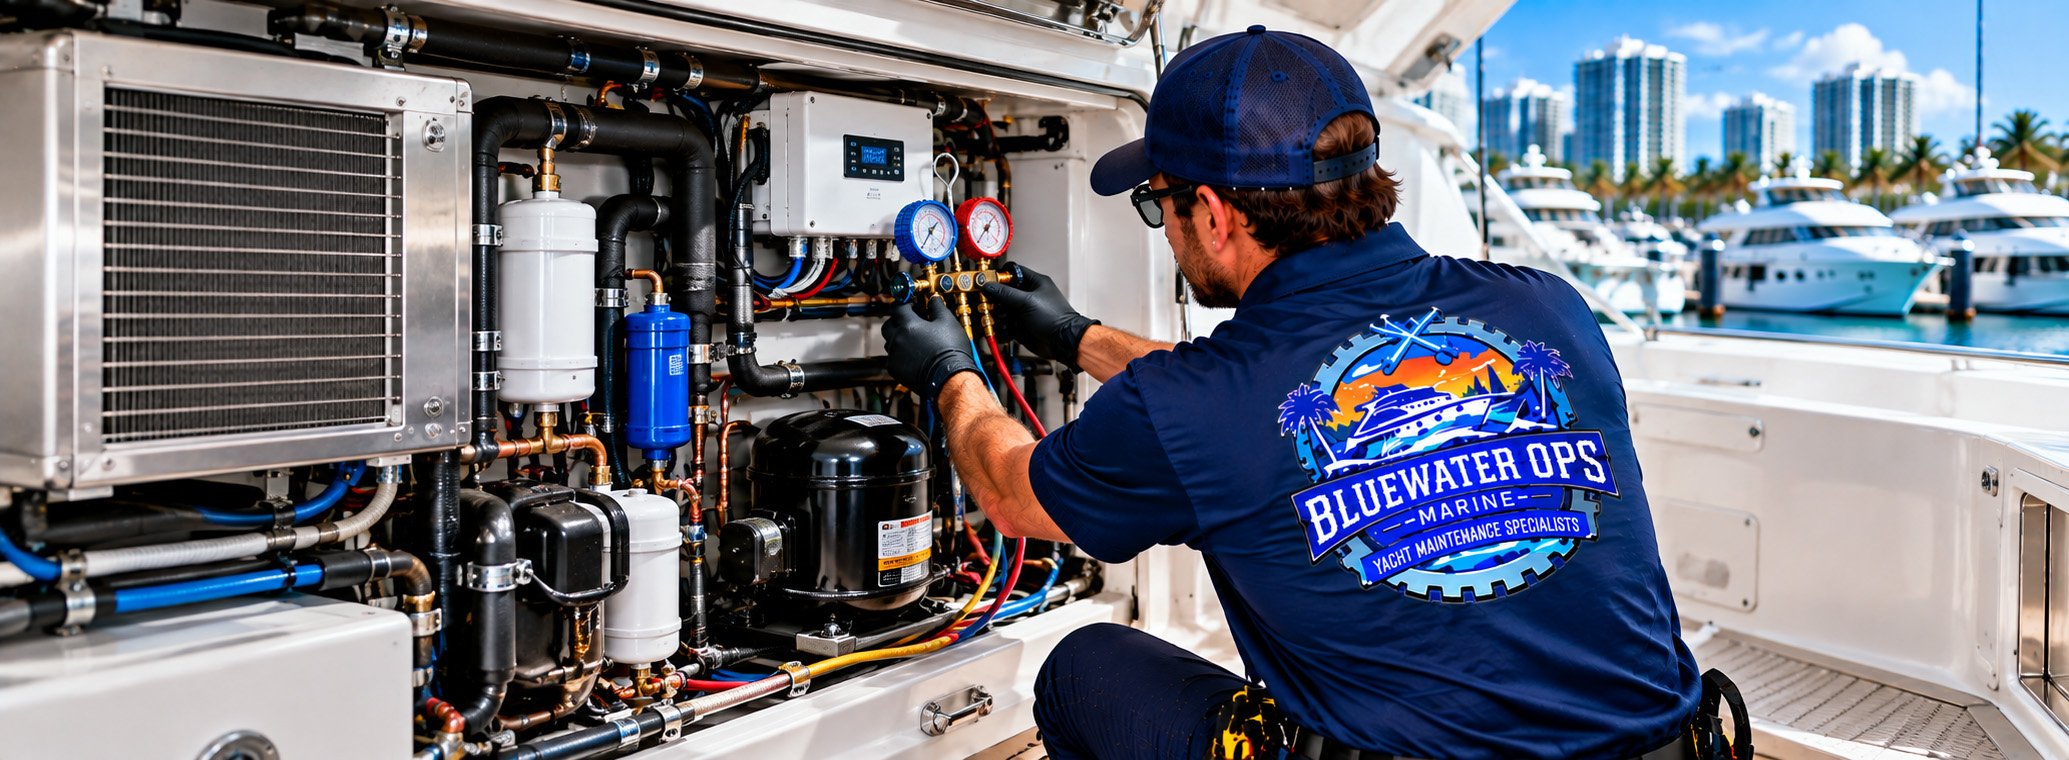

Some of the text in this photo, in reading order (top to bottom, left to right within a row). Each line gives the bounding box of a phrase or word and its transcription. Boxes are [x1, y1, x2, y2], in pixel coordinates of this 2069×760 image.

[1305, 440, 1605, 545] BLUEWATER OPS
[1420, 491, 1515, 525] MARINE
[1373, 548, 1412, 575] YACHT
[1505, 517, 1580, 536] SPECIALISTS
